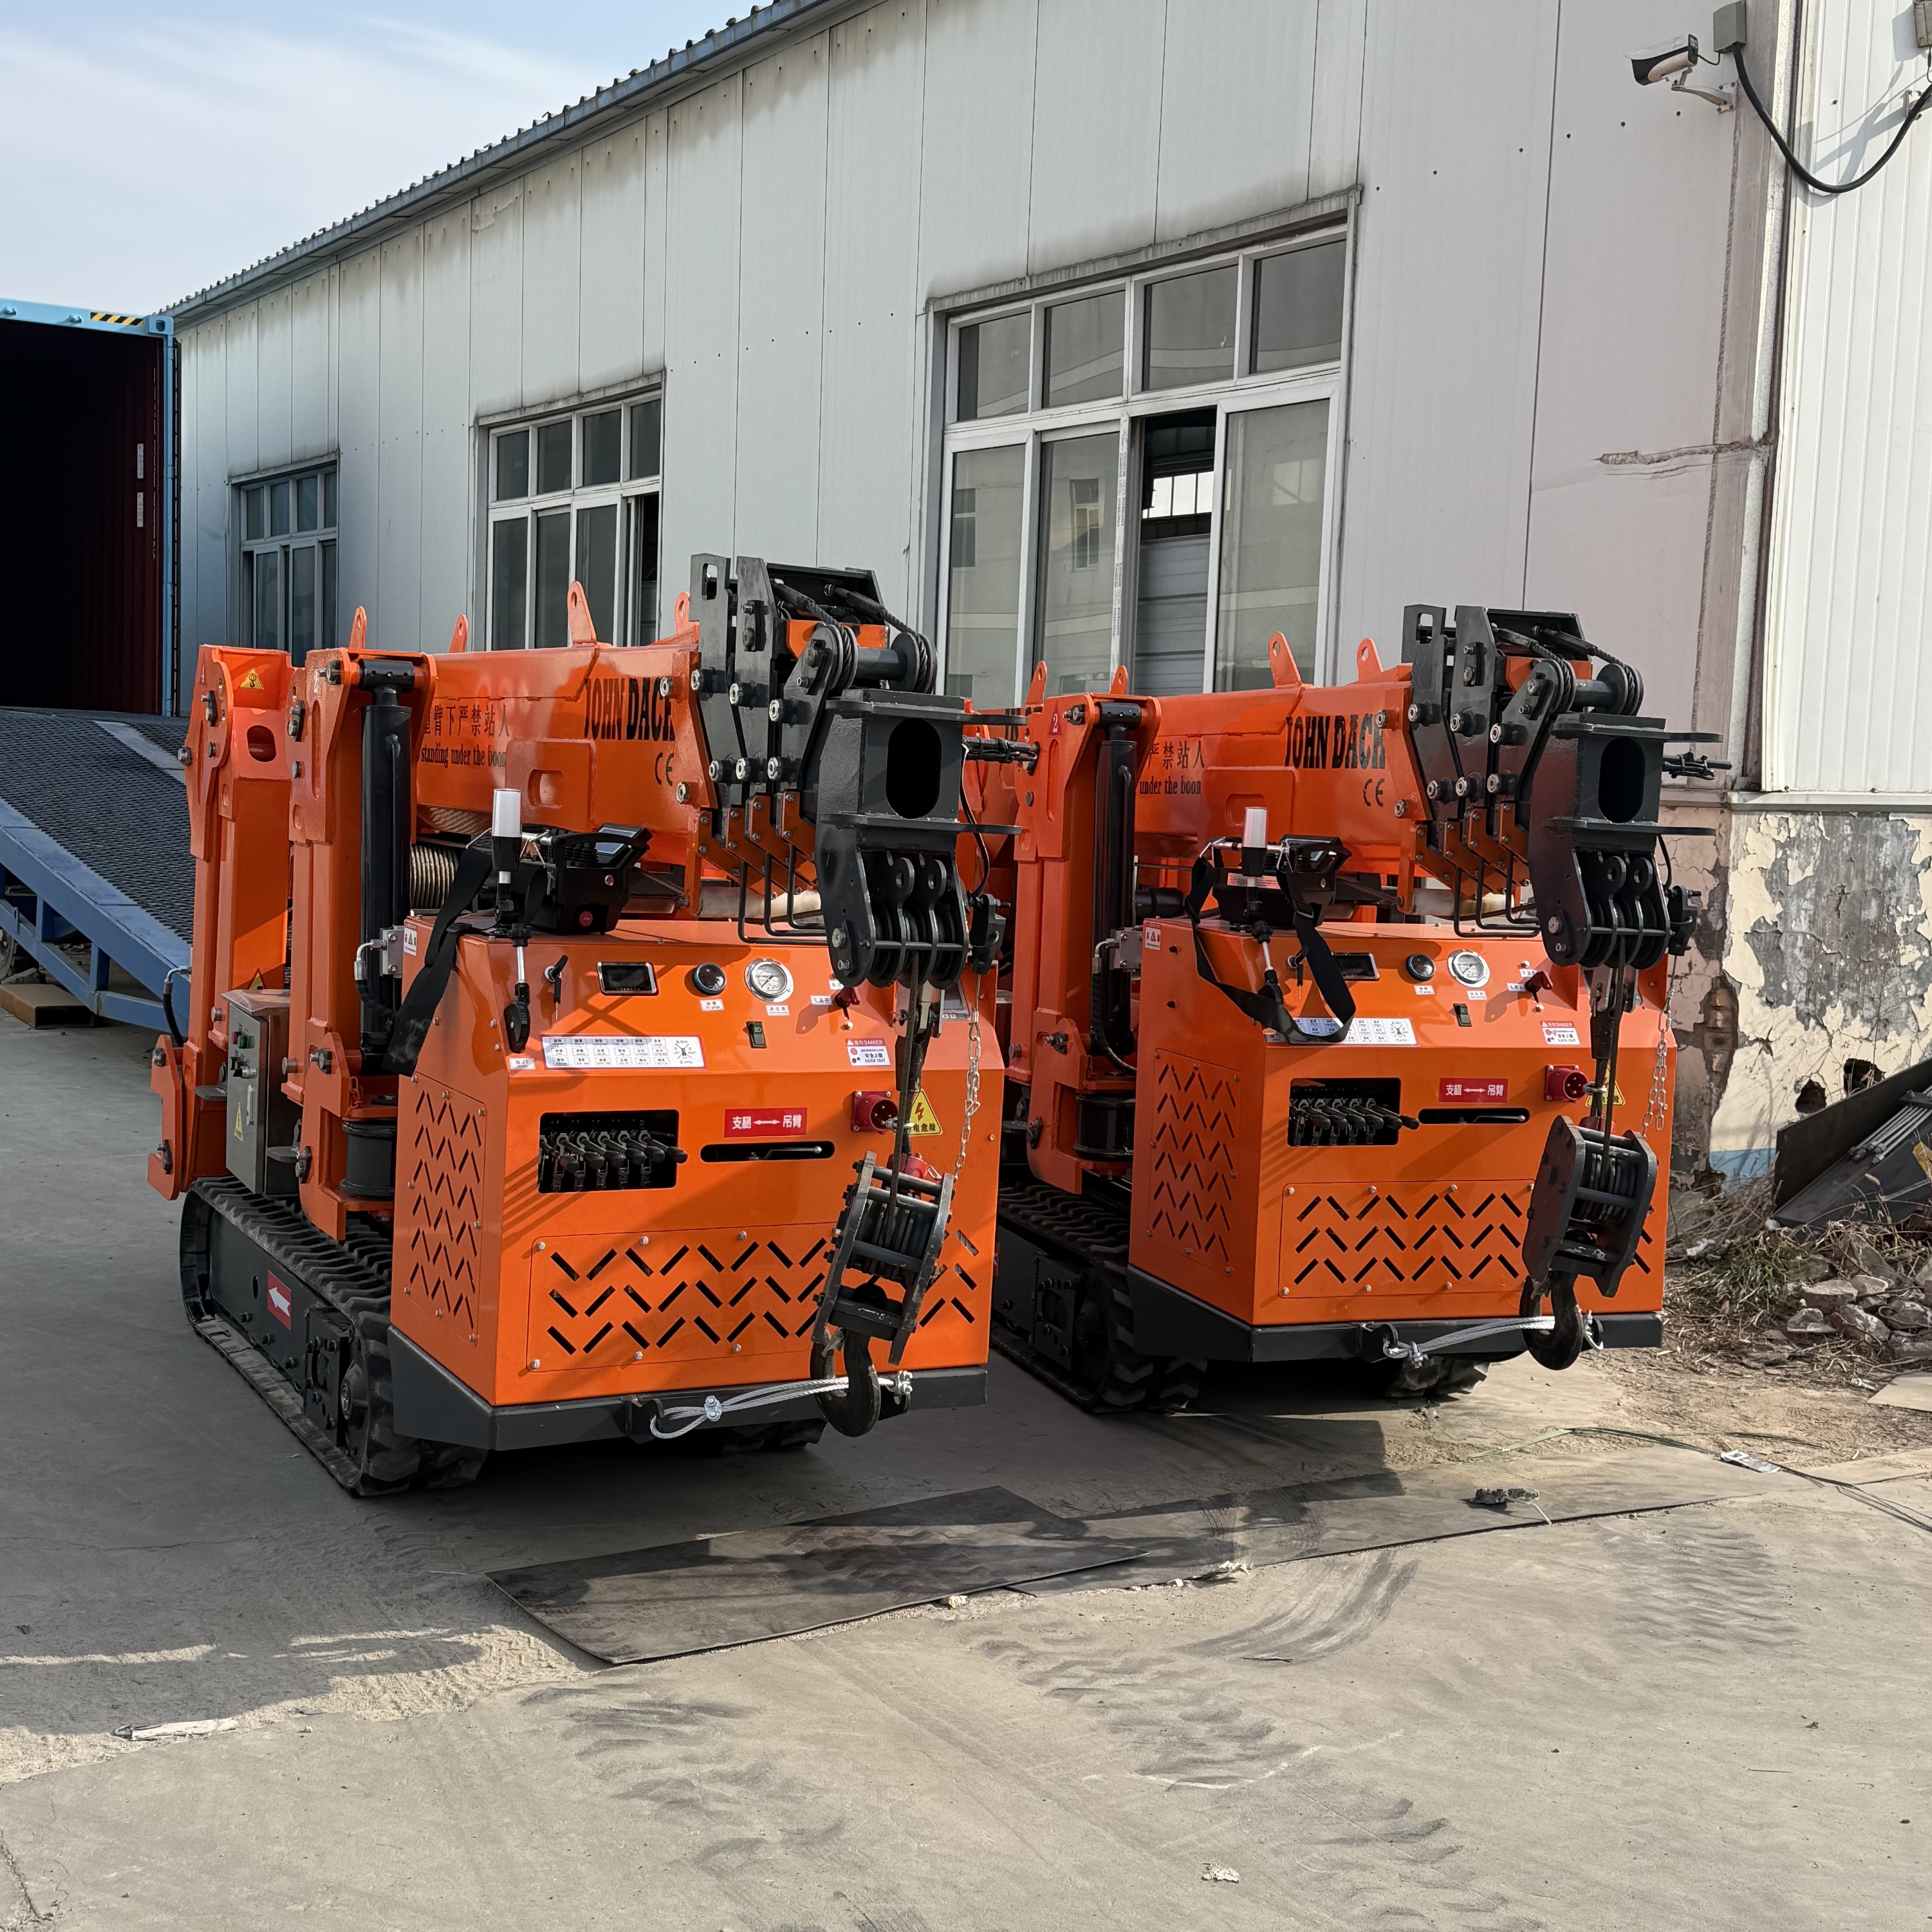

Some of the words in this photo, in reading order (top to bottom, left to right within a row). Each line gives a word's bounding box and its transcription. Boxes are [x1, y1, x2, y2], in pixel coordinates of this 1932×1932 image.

[584, 677, 625, 741] JOHN
[1052, 713, 1058, 733] 2
[421, 742, 448, 768] standing
[451, 743, 471, 765] under
[473, 744, 485, 766] the
[1285, 715, 1331, 769] JOHN
[655, 752, 674, 787] CE
[1140, 775, 1162, 795] under
[1164, 775, 1178, 795] the
[1363, 778, 1385, 807] CE
[1488, 1085, 1504, 1096] 吊臂
[732, 1116, 752, 1130] 支腿
[783, 1114, 802, 1128] 吊臂
